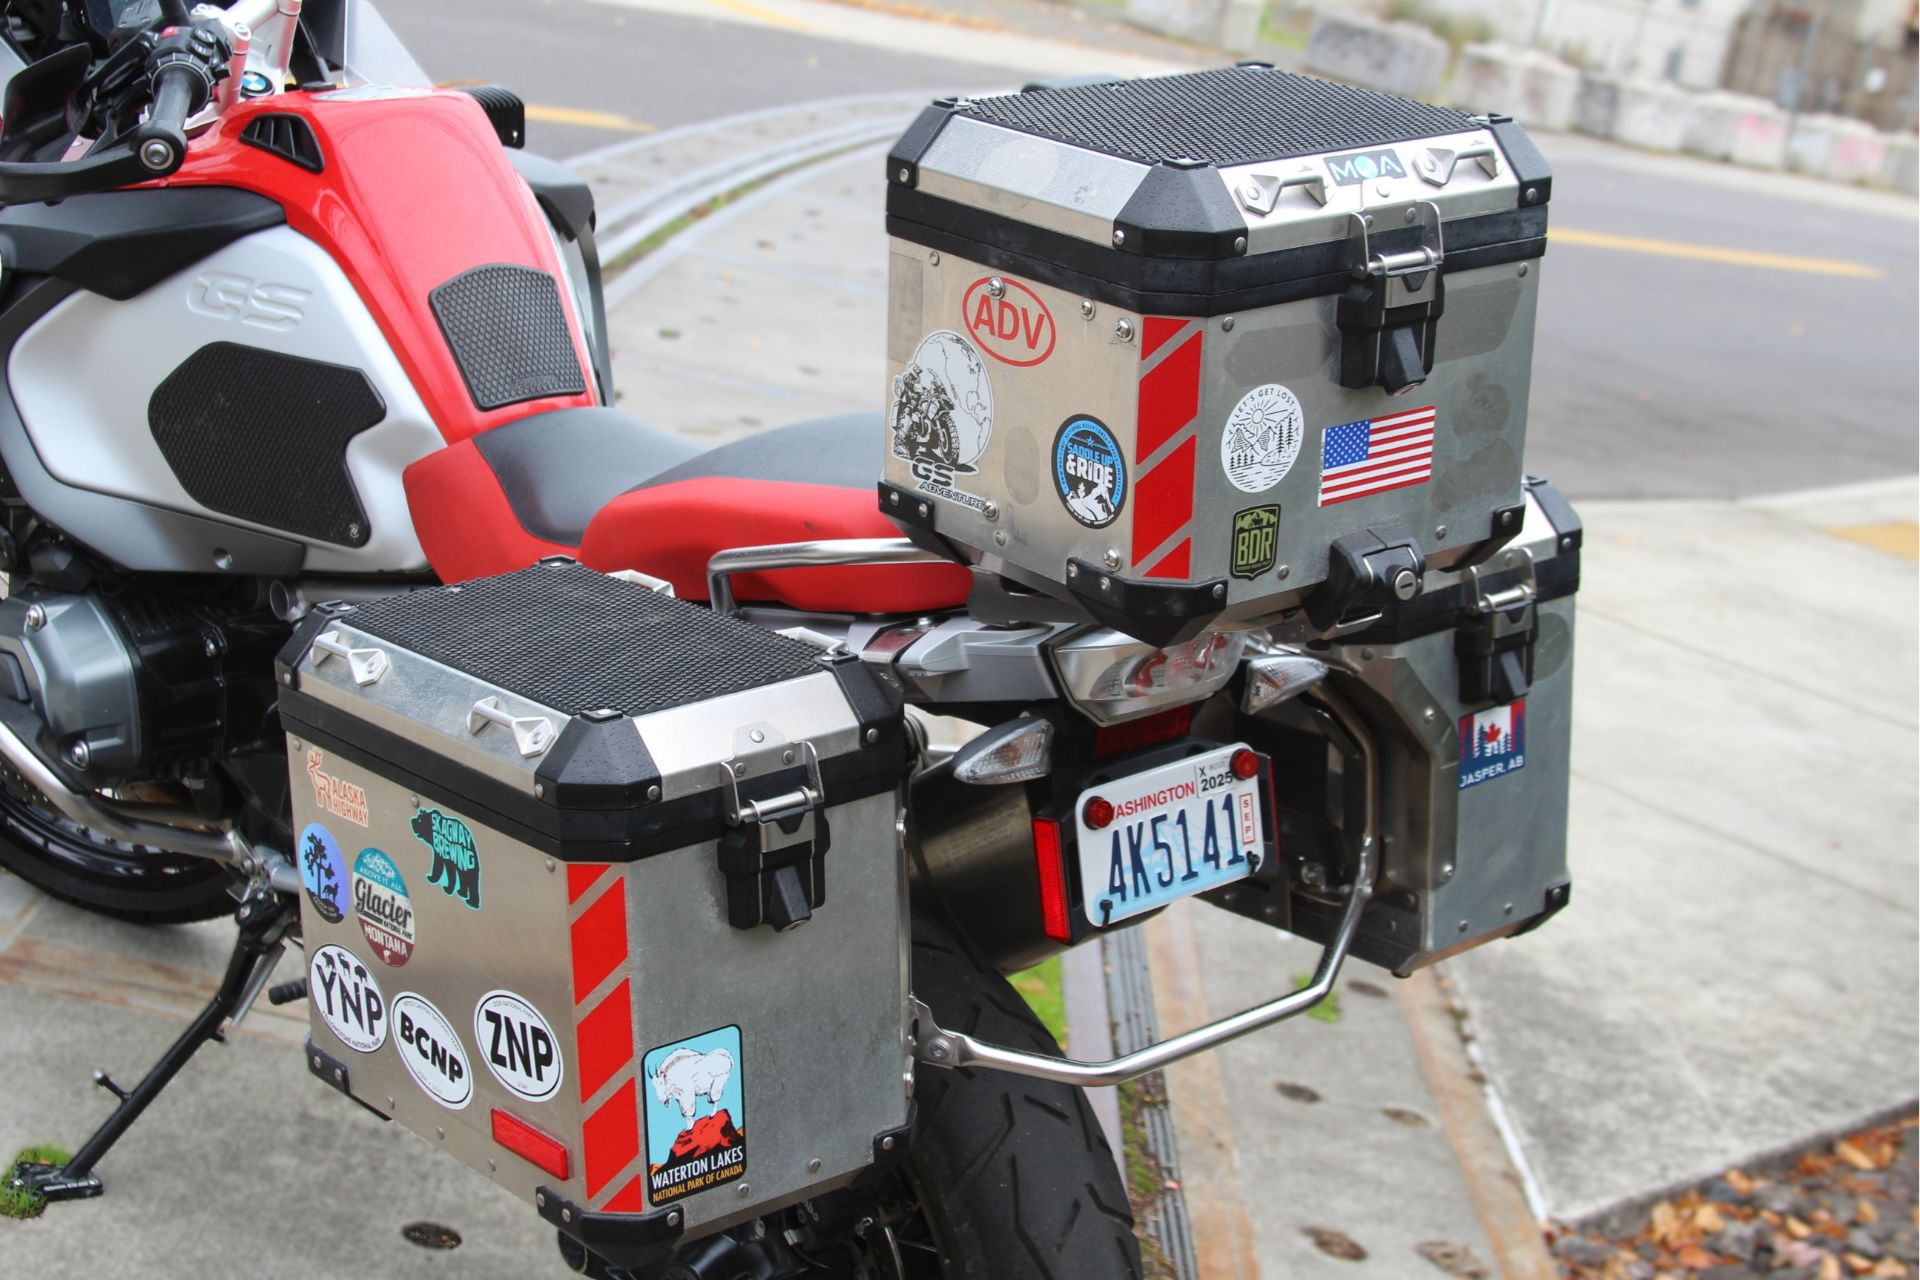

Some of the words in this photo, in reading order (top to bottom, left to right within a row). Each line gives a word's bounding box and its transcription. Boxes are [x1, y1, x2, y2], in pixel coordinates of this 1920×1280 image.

[186, 270, 312, 332] GS
[973, 294, 1045, 350] ADV
[1234, 394, 1255, 418] LET'S
[1258, 388, 1274, 397] GET
[1277, 390, 1295, 406] LOST
[912, 457, 954, 487] GS
[1066, 442, 1099, 463] SADDLE
[1101, 453, 1113, 466] UP
[920, 481, 987, 510] ADVENTURE
[1237, 528, 1273, 566] BDR
[1198, 766, 1206, 778] X
[1508, 755, 1523, 770] AB
[332, 778, 366, 807] ALASKA
[1201, 771, 1233, 792] 2025
[333, 801, 367, 825] HIGHWAY
[1111, 781, 1195, 821] ASHINGTON
[1243, 799, 1251, 835] SEP
[432, 813, 471, 850] SKAGWAY
[1109, 793, 1245, 902] 4K5141
[433, 831, 475, 871] BREWING
[360, 866, 380, 882] ABOVE
[382, 877, 388, 886] IT
[391, 882, 401, 892] ALL
[355, 877, 412, 928] Glacier
[364, 922, 408, 958] MONTANA
[383, 920, 401, 934] NATIONAL
[402, 929, 412, 940] PARK
[315, 963, 383, 1036] YNP
[401, 1010, 463, 1084] BCNP
[485, 1009, 553, 1082] ZNP
[651, 1156, 708, 1190] WATERTON
[710, 1145, 743, 1171] LAKES
[652, 1183, 687, 1202] NATIONAL
[687, 1176, 705, 1190] PARK
[706, 1174, 715, 1185] OF
[716, 1163, 743, 1181] CANADA
